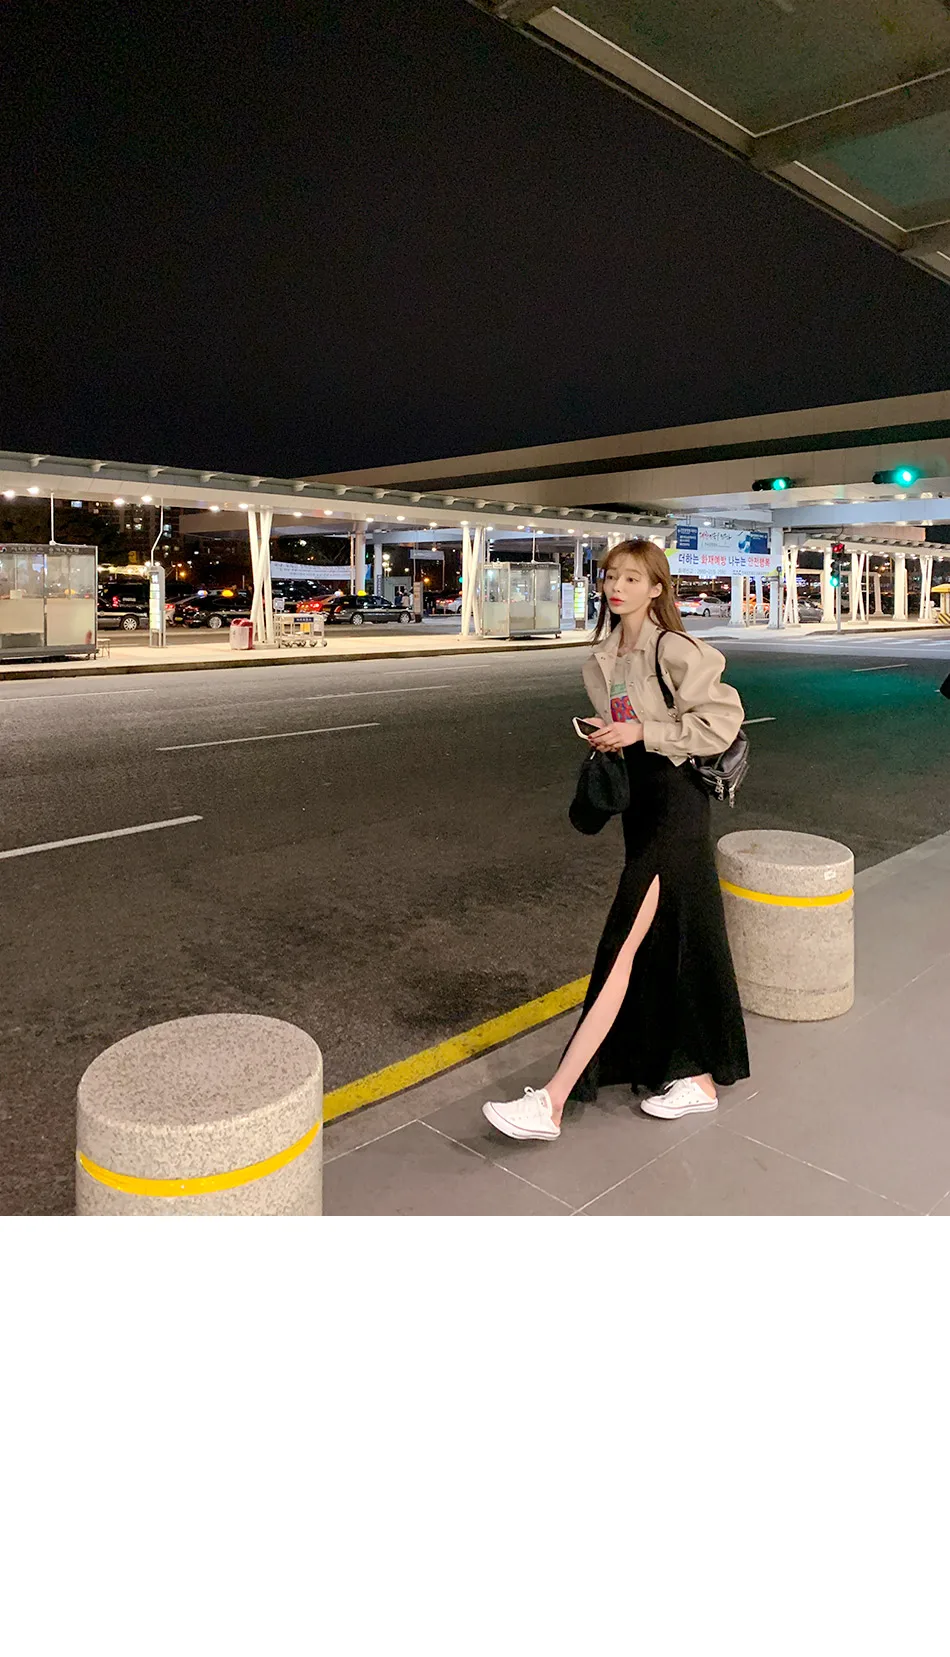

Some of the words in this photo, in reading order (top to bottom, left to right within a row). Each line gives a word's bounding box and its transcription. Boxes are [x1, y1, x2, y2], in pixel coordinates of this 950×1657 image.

[678, 553, 699, 565] 더하는
[701, 554, 727, 566] 화재예방
[728, 556, 746, 567] 나누는
